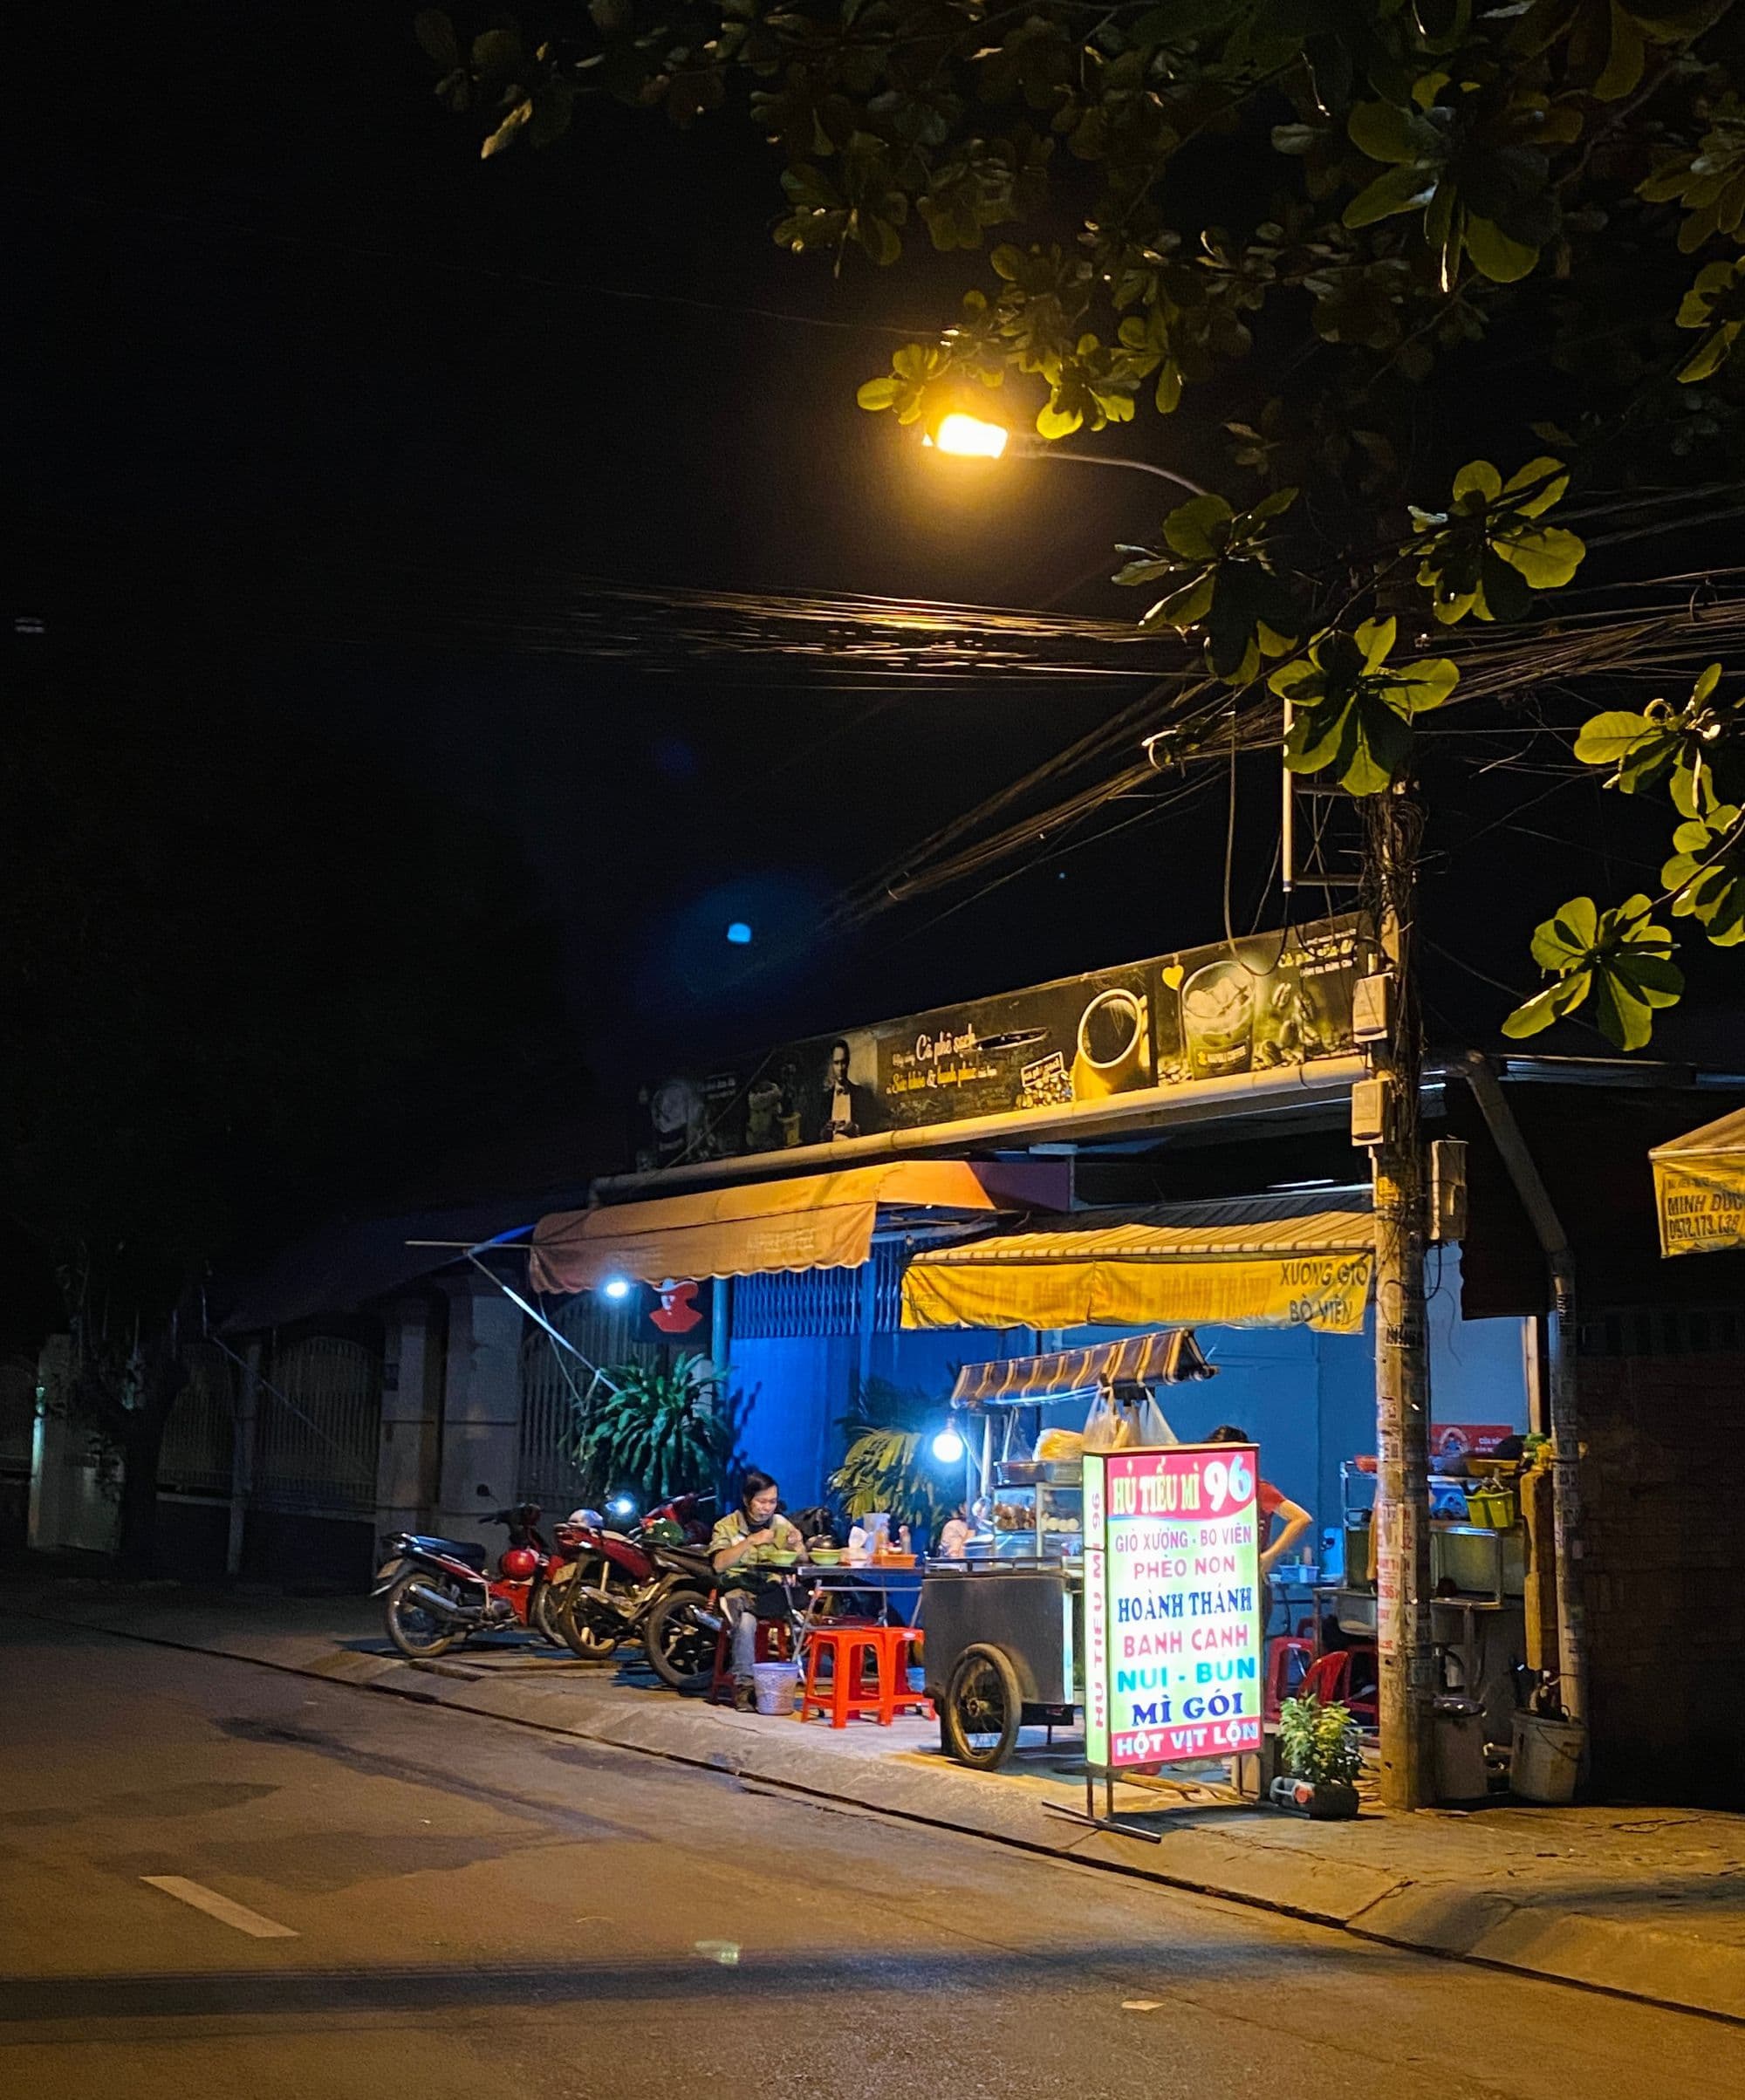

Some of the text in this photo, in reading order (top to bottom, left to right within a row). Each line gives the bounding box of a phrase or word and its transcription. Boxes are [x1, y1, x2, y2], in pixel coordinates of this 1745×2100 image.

[1203, 1454, 1253, 1513] 96
[1194, 1556, 1235, 1577] NON
[1132, 1687, 1244, 1727] MÌ GÓI
[1117, 1720, 1258, 1760] HỘT VỊT LỘN
